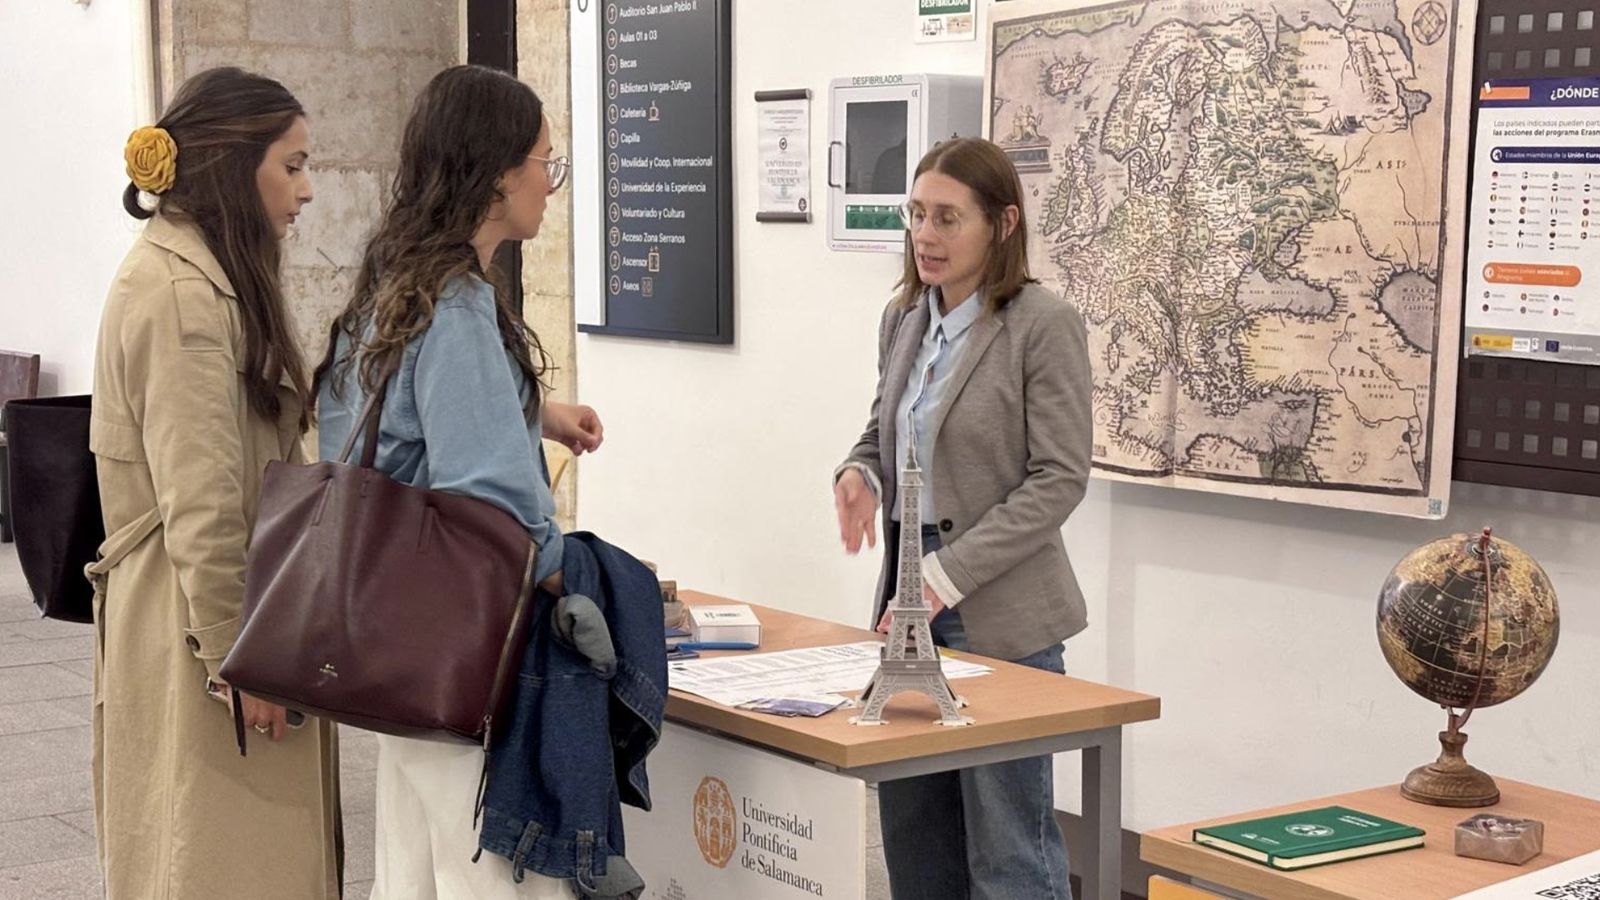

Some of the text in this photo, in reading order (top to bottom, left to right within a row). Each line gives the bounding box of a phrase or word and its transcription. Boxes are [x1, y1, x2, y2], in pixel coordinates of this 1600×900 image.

[619, 7, 646, 18] Auditorio
[646, 5, 658, 15] San
[659, 4, 674, 14] Juan
[674, 1, 691, 12] Pablo
[619, 33, 635, 43] Aulas
[636, 32, 644, 42] 01
[649, 30, 658, 41] 03
[619, 59, 637, 69] Becas
[852, 74, 903, 86] DESFIBRILADOR
[620, 82, 649, 94] Biblioteca
[1550, 85, 1600, 101] ¿DÓNDE
[620, 133, 641, 145] Capilla
[1492, 128, 1502, 136] las
[1503, 129, 1533, 137] acciones
[1533, 128, 1545, 136] del
[1545, 129, 1579, 138] programa
[1567, 151, 1585, 159] Unión
[621, 157, 649, 168] Movilidad
[654, 157, 672, 169] Coop.
[673, 156, 713, 167] Internacional
[621, 182, 655, 193] Universidad
[656, 182, 664, 193] de
[671, 182, 707, 194] Experiencia
[621, 208, 657, 219] Voluntariado
[663, 208, 686, 219] Cultura
[622, 232, 686, 244] Acceso Zona Serranos
[622, 256, 648, 267] Ascensor
[622, 281, 640, 292] Aseos
[743, 797, 812, 840] Universidad
[742, 822, 798, 861] Pontificia
[741, 849, 823, 896] de Salamanca
